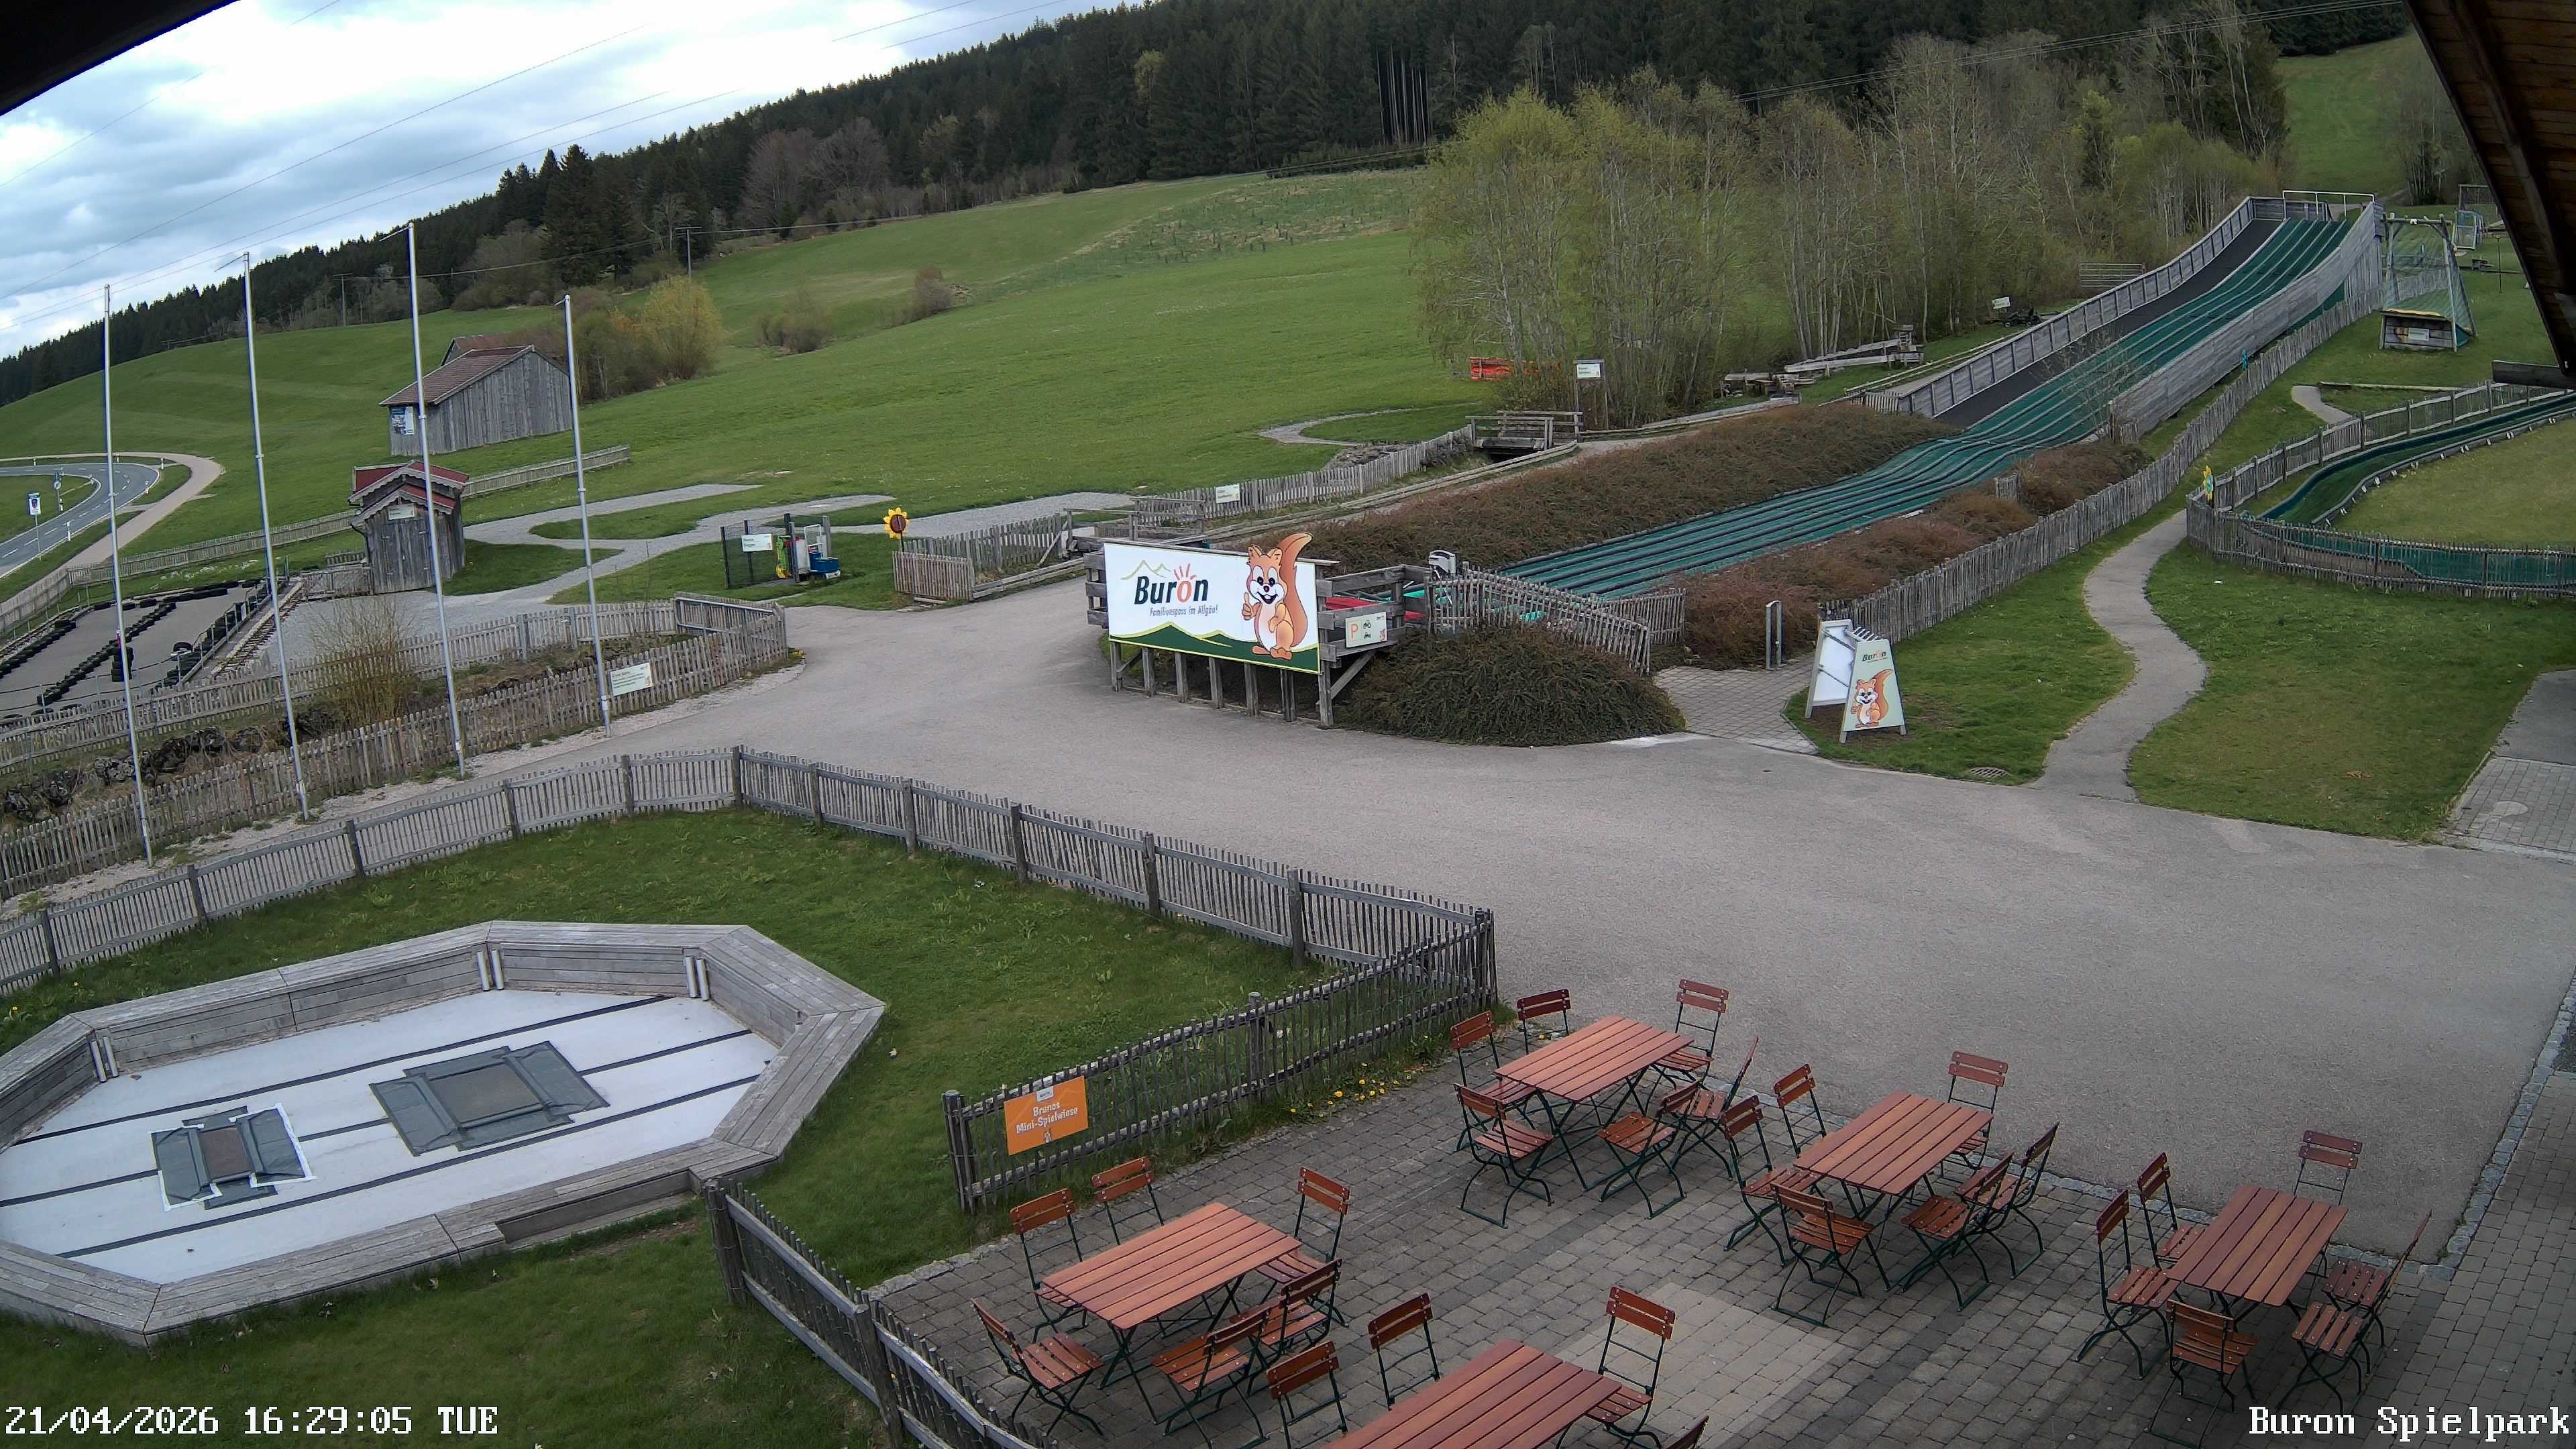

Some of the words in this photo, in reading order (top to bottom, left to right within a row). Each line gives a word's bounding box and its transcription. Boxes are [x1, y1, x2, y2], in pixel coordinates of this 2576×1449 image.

[1134, 576, 1209, 605] Buron
[1189, 606, 1195, 614] im
[1350, 623, 1358, 639] P
